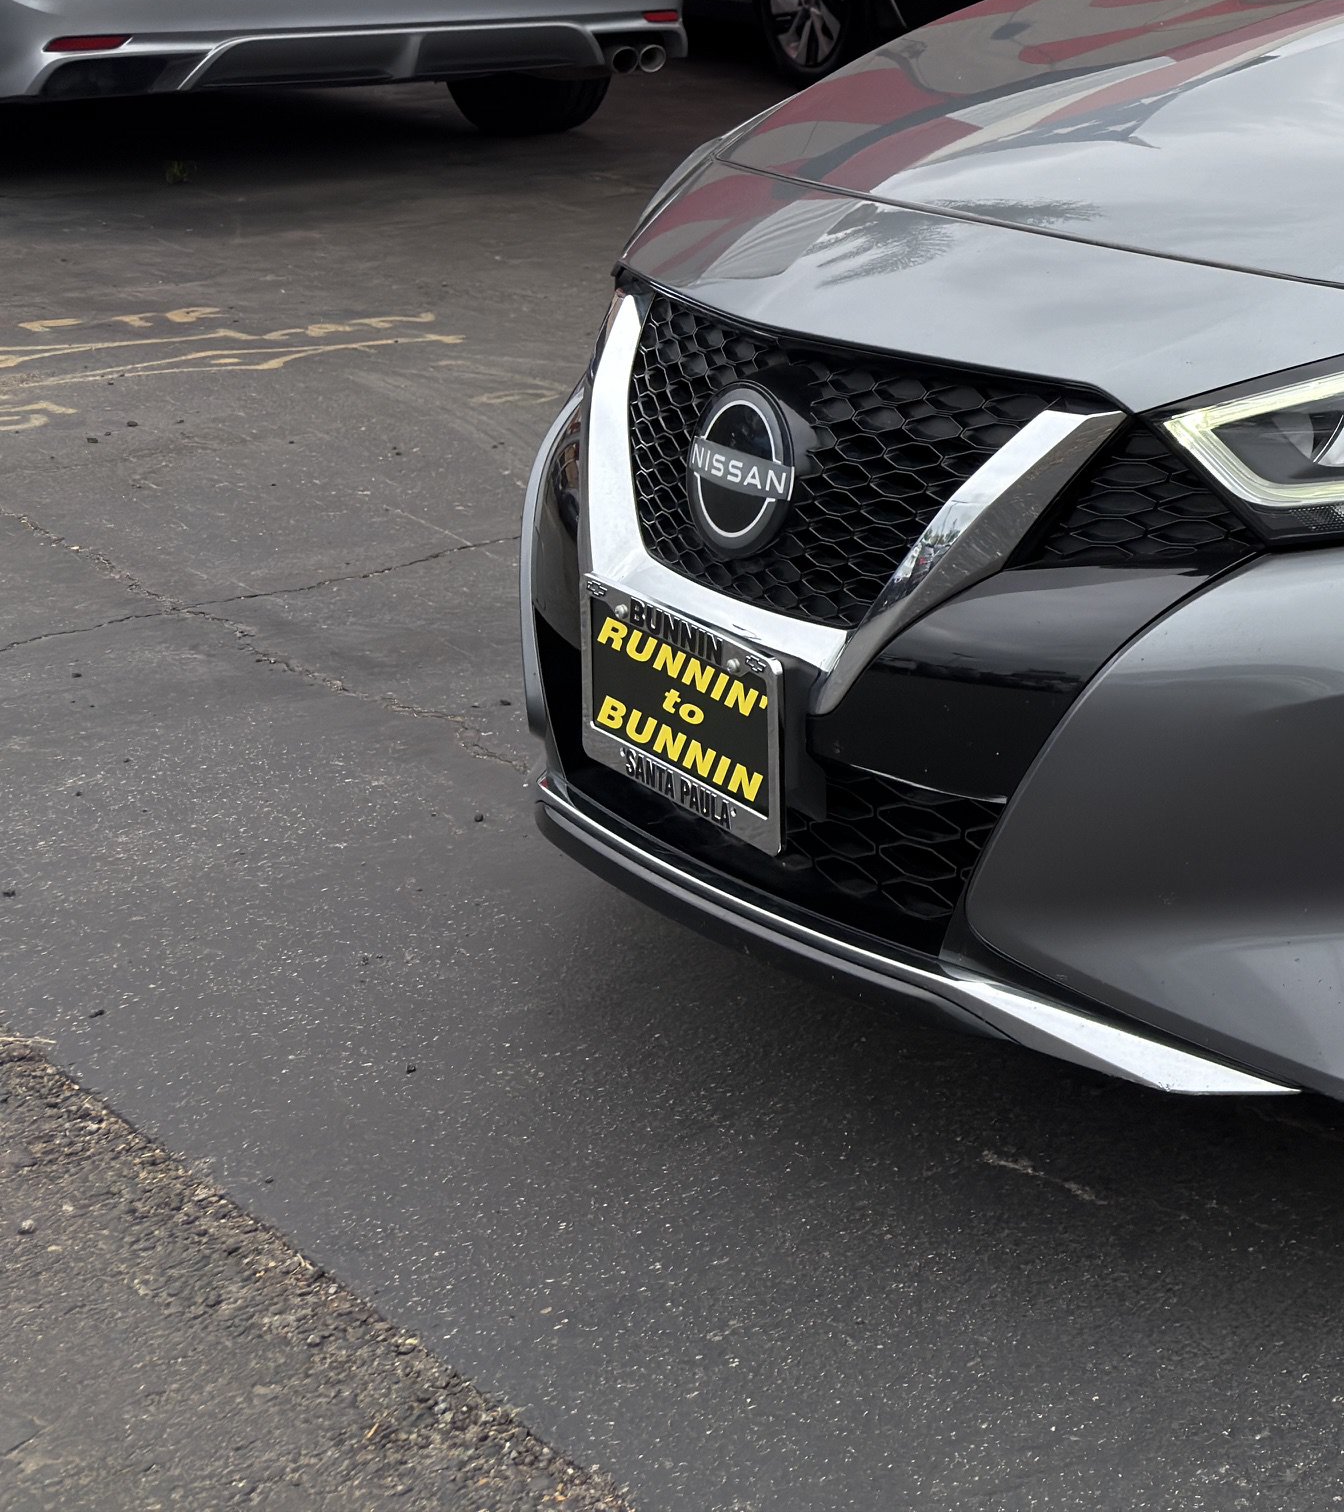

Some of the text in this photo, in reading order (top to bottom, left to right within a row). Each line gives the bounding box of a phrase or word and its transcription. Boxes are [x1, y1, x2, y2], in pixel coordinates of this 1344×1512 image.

[691, 441, 788, 496] NISSAN
[597, 616, 768, 717] RUNNIN'
[630, 596, 723, 667] BUNNIN
[662, 688, 705, 725] to
[597, 695, 764, 802] BUNNIN
[625, 747, 732, 830] SANTA PAULA
